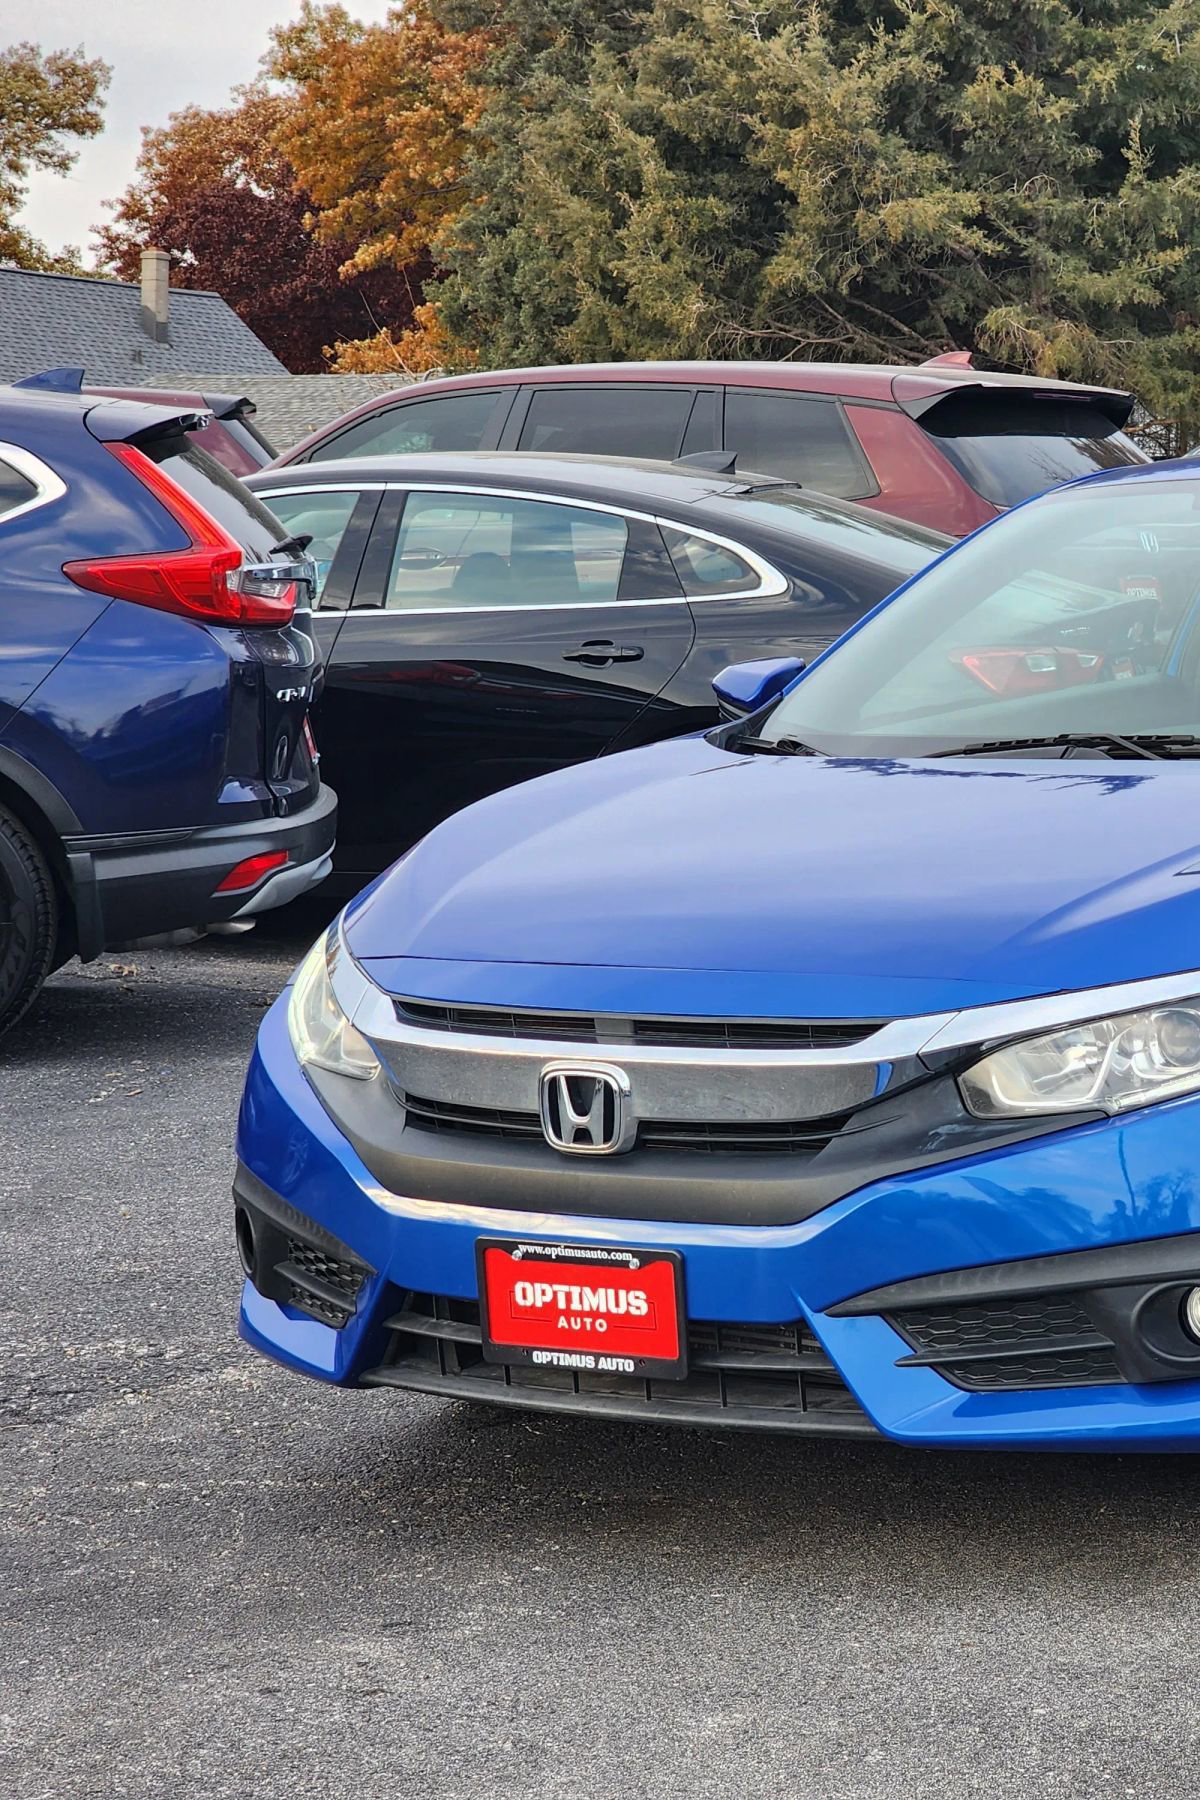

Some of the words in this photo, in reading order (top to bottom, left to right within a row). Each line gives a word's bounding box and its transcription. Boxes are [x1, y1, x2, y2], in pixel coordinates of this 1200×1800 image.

[518, 1245, 633, 1261] www.optimusauto.com
[514, 1281, 648, 1315] OPTIMUS
[557, 1316, 607, 1332] AUTO
[533, 1351, 595, 1370] OPTIMUS
[598, 1358, 635, 1372] AUTO
